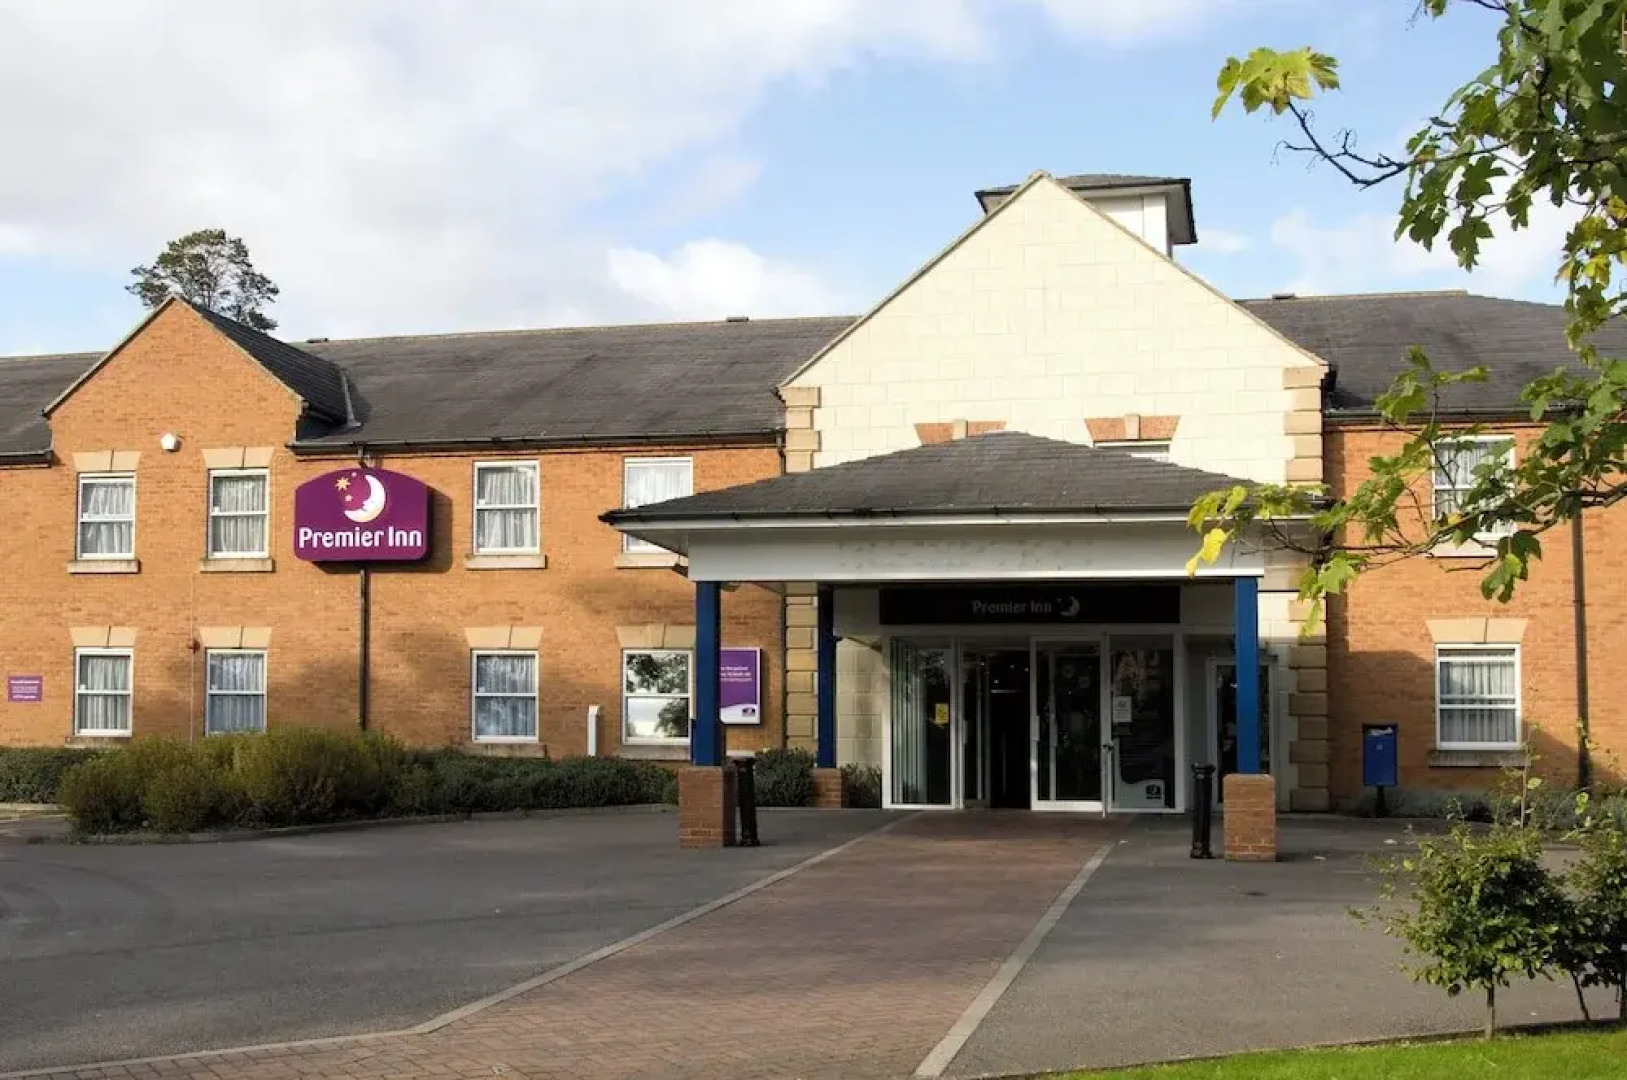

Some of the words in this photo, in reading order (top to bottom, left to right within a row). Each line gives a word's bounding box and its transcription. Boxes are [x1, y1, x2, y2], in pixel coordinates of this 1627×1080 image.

[298, 526, 384, 549] Premier
[388, 526, 422, 548] Inn
[972, 600, 1026, 614] Premier
[1031, 600, 1052, 613] Inn
